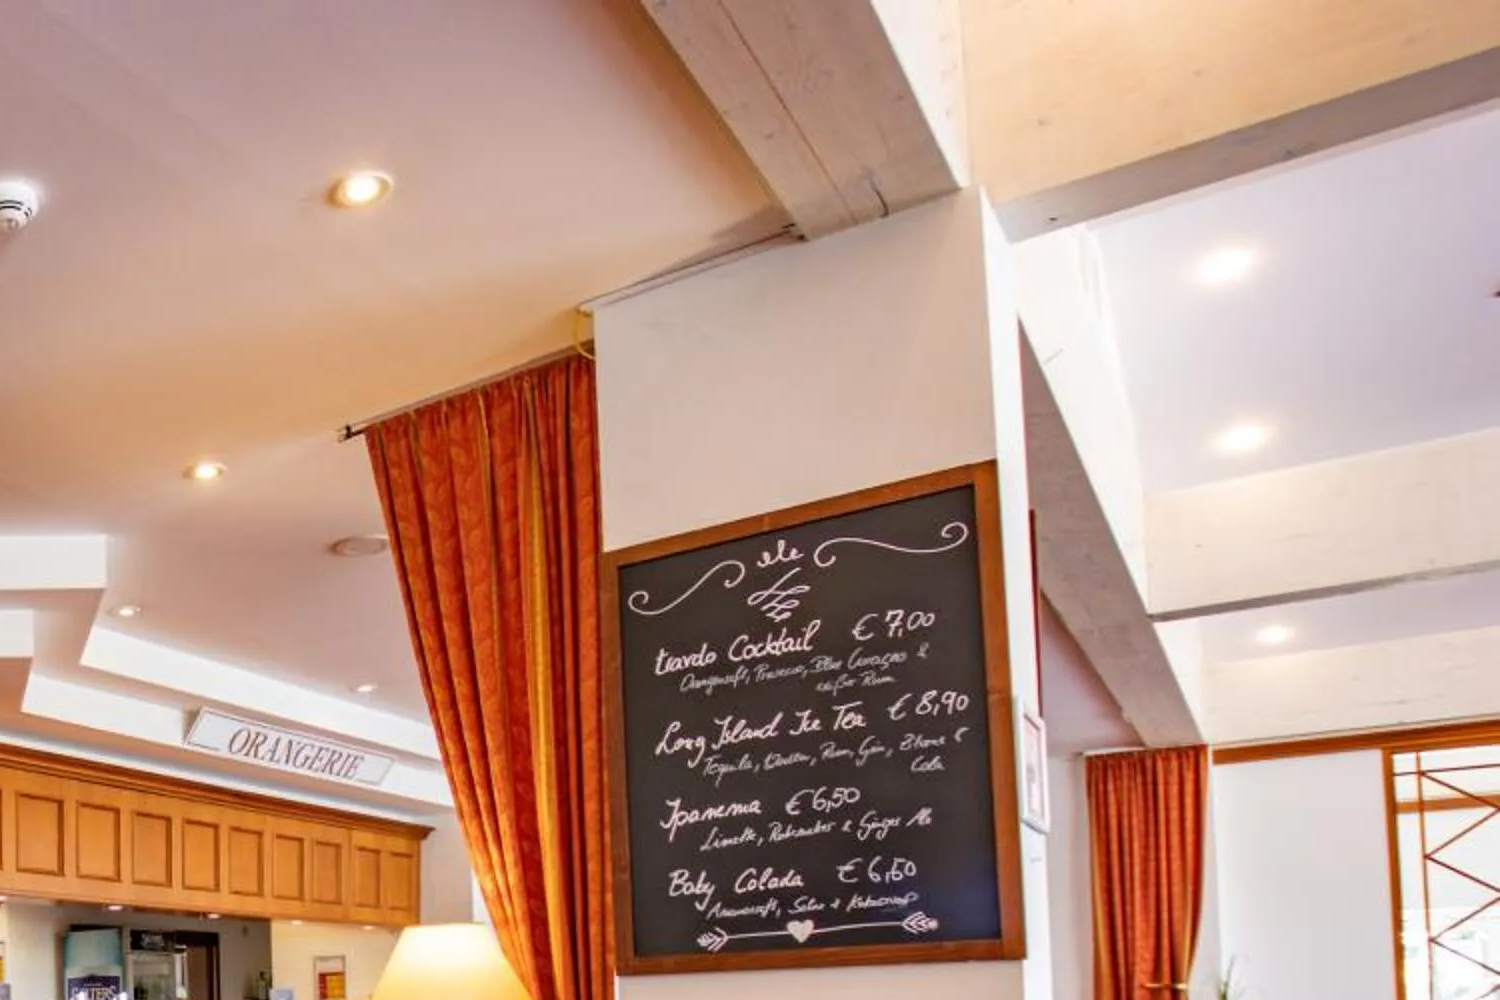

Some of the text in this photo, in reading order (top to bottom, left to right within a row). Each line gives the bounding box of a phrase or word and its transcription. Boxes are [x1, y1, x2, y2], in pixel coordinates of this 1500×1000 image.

[727, 620, 822, 662] Cocktail
[851, 614, 878, 641] €
[884, 609, 935, 637] 7,00
[228, 727, 366, 779] ORANGERIE
[654, 720, 706, 768] Long
[711, 711, 784, 750] Island
[789, 709, 823, 735] Ice
[832, 701, 868, 731] Tea
[914, 690, 970, 716] 8,90
[659, 786, 861, 842] Ipanema € 6,50
[668, 868, 716, 911] Baby
[734, 867, 805, 895] Colada
[836, 857, 863, 884] €
